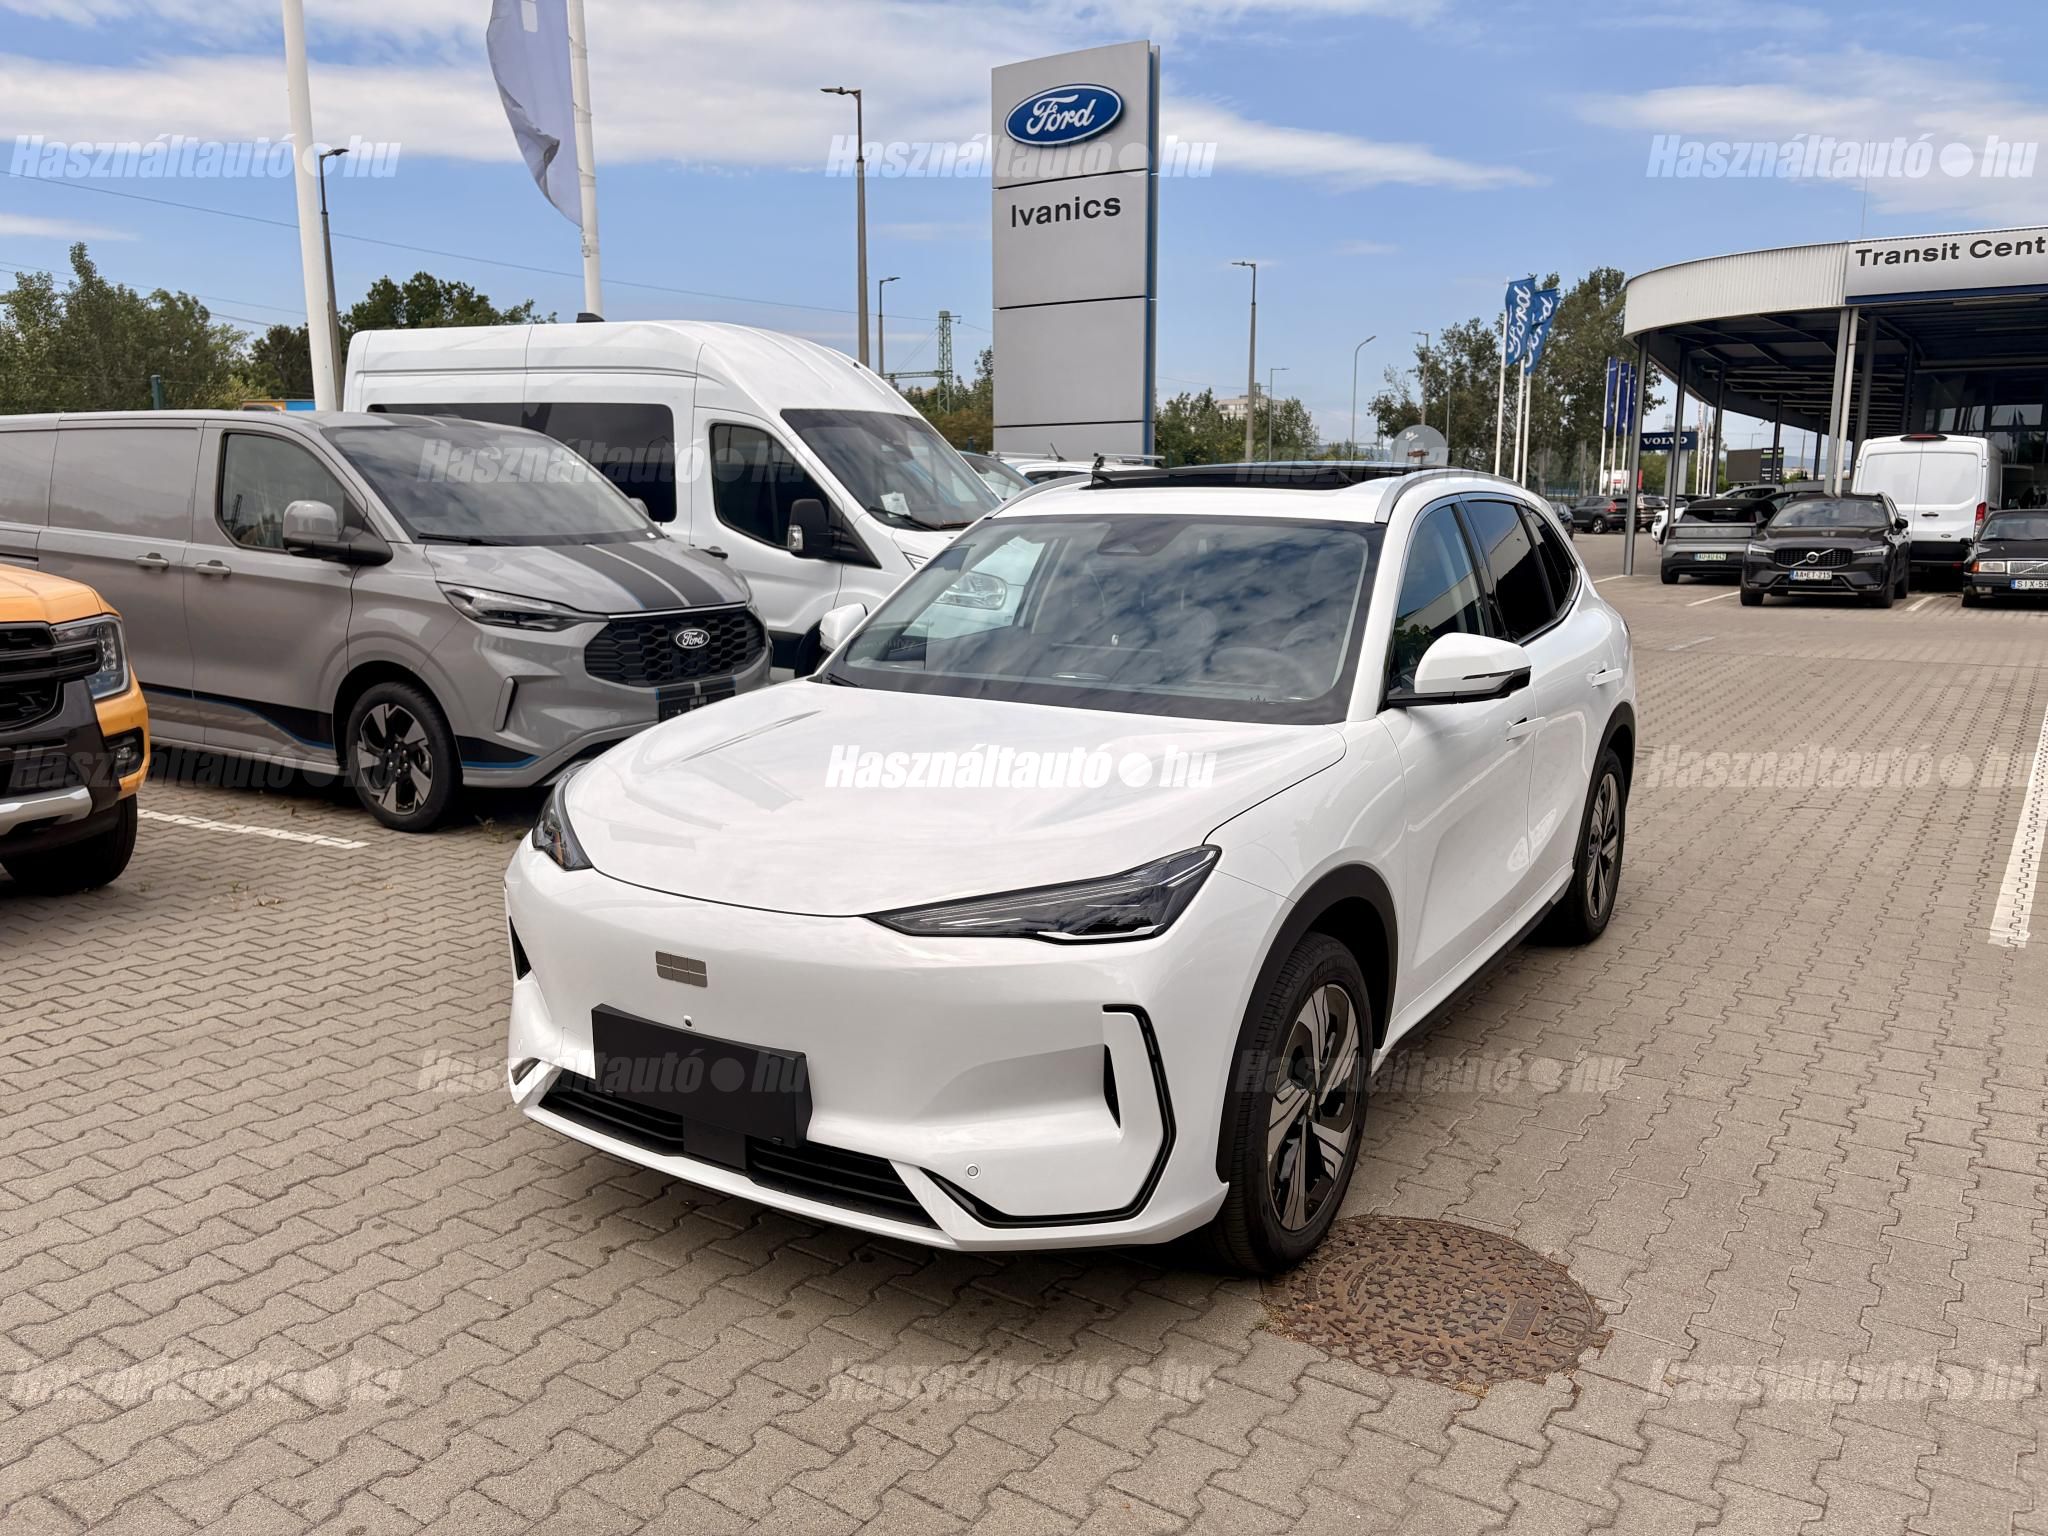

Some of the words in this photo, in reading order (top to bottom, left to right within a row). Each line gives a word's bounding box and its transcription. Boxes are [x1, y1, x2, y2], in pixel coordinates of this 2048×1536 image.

[1026, 94, 1096, 135] Ford
[1011, 196, 1121, 228] Ivanics
[1856, 242, 1960, 267] Transit
[1969, 236, 2047, 258] Cent
[1507, 285, 1531, 360] Ford
[682, 631, 705, 646] Ford
